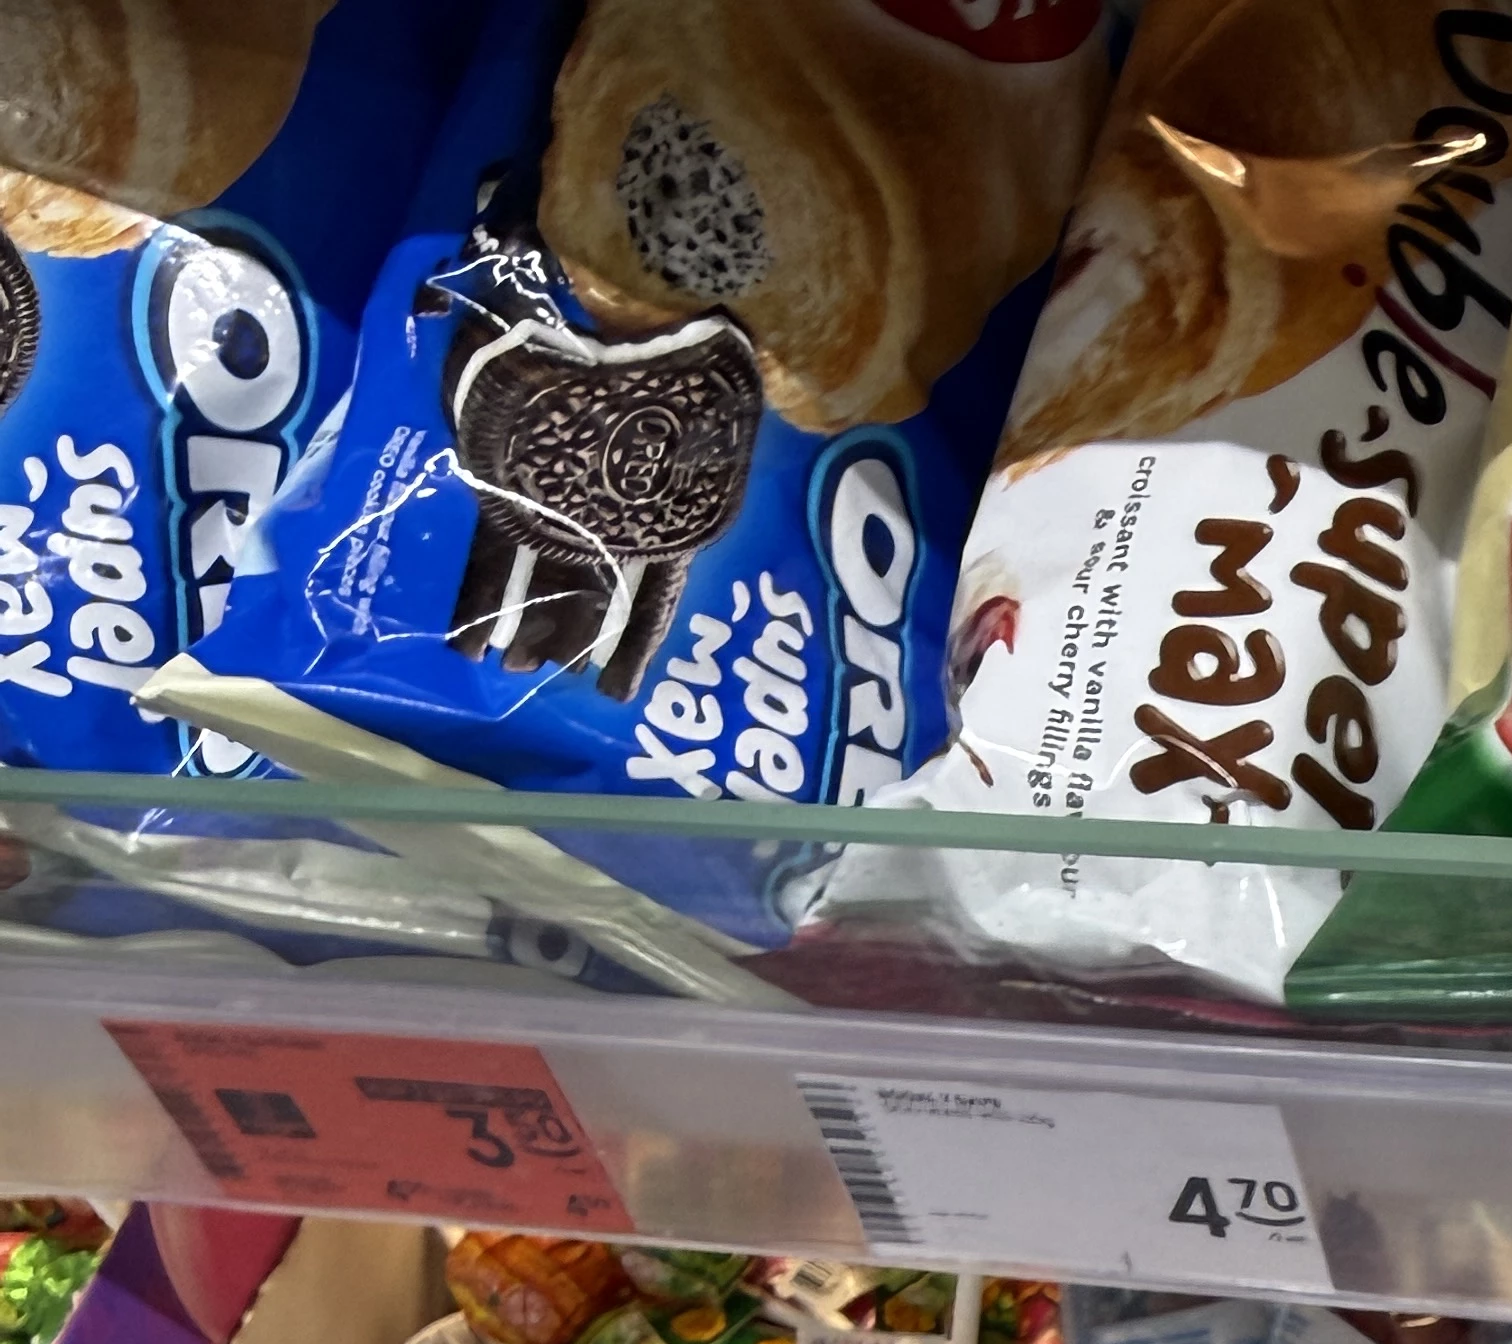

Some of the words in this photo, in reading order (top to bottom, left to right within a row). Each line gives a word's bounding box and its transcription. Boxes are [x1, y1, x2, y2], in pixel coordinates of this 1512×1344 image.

[1105, 455, 1157, 573] croissant
[1071, 540, 1107, 595] sour
[1090, 583, 1123, 650] with
[1047, 603, 1091, 700] cherry
[1026, 707, 1075, 809] fillings
[1070, 660, 1106, 760] vanilla
[1060, 770, 1094, 900] flaour
